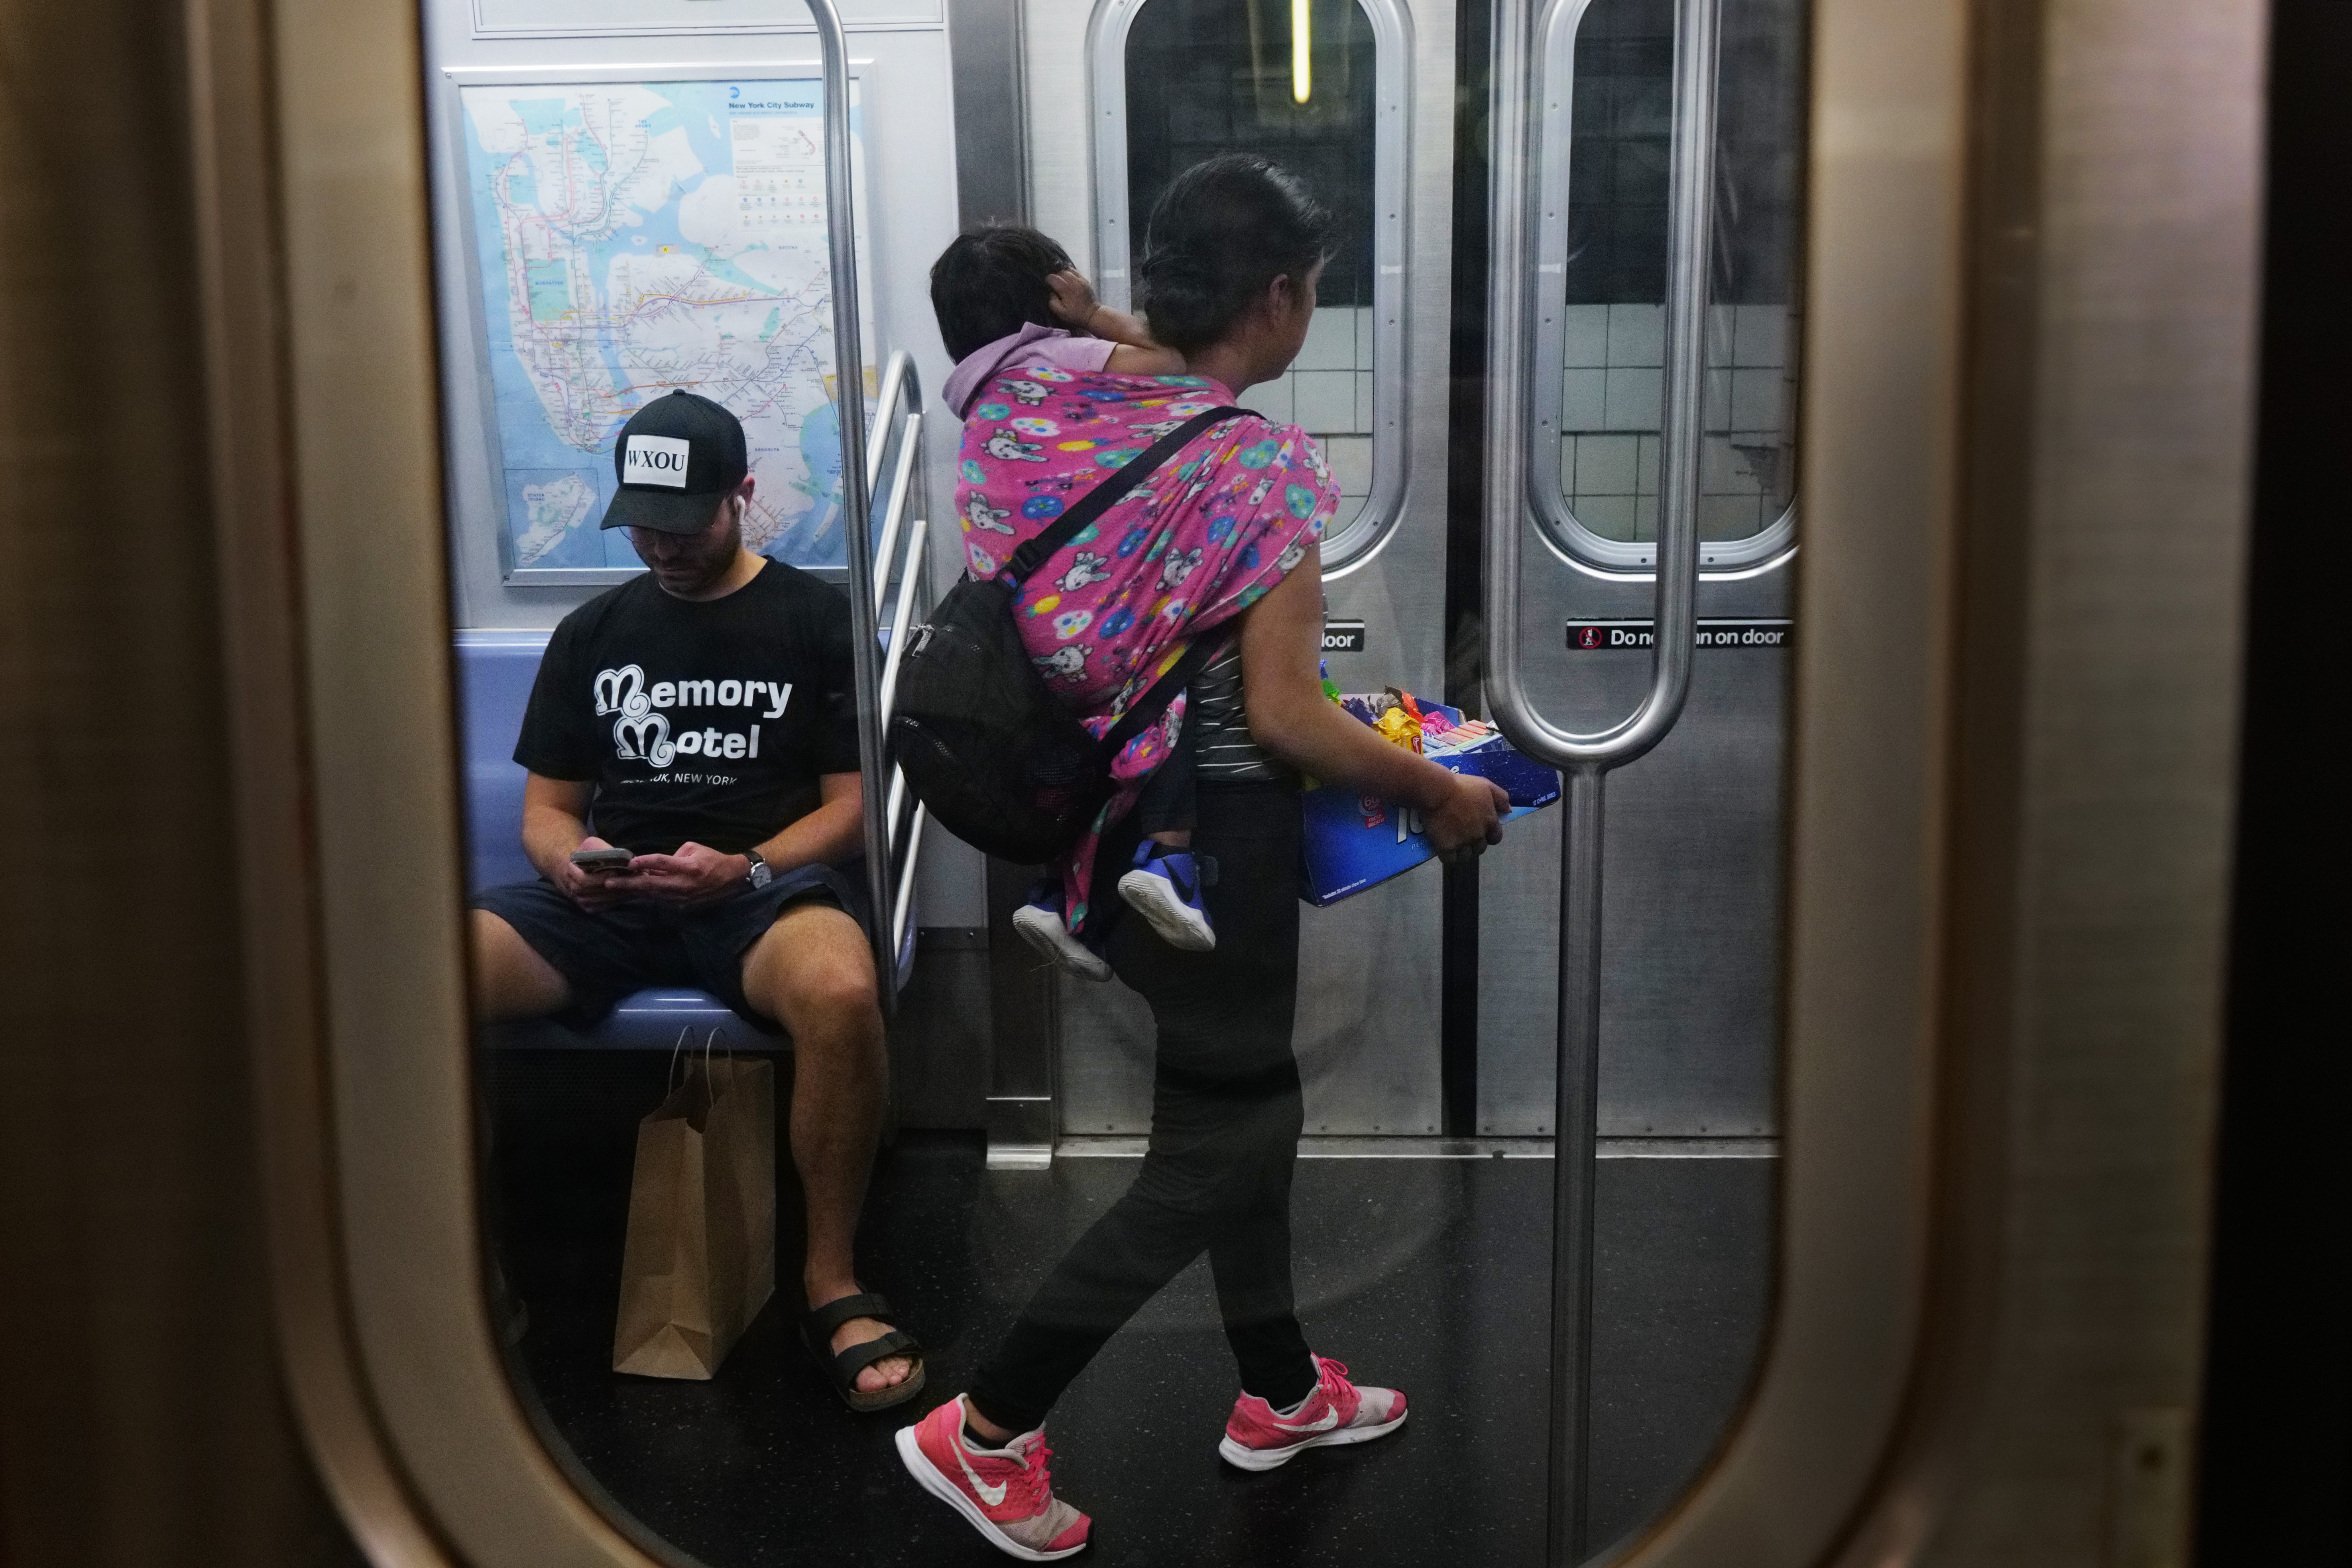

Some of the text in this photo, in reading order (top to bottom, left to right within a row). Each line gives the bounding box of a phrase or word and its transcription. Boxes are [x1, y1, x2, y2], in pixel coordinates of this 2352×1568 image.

[628, 450, 685, 471] WXOU
[1611, 630, 1636, 645] Do
[1715, 633, 1738, 644] on
[1742, 629, 1784, 645] door
[594, 664, 793, 719] Memory
[613, 712, 760, 768] Motel
[674, 773, 702, 783] NEW
[706, 775, 737, 785] YORK
